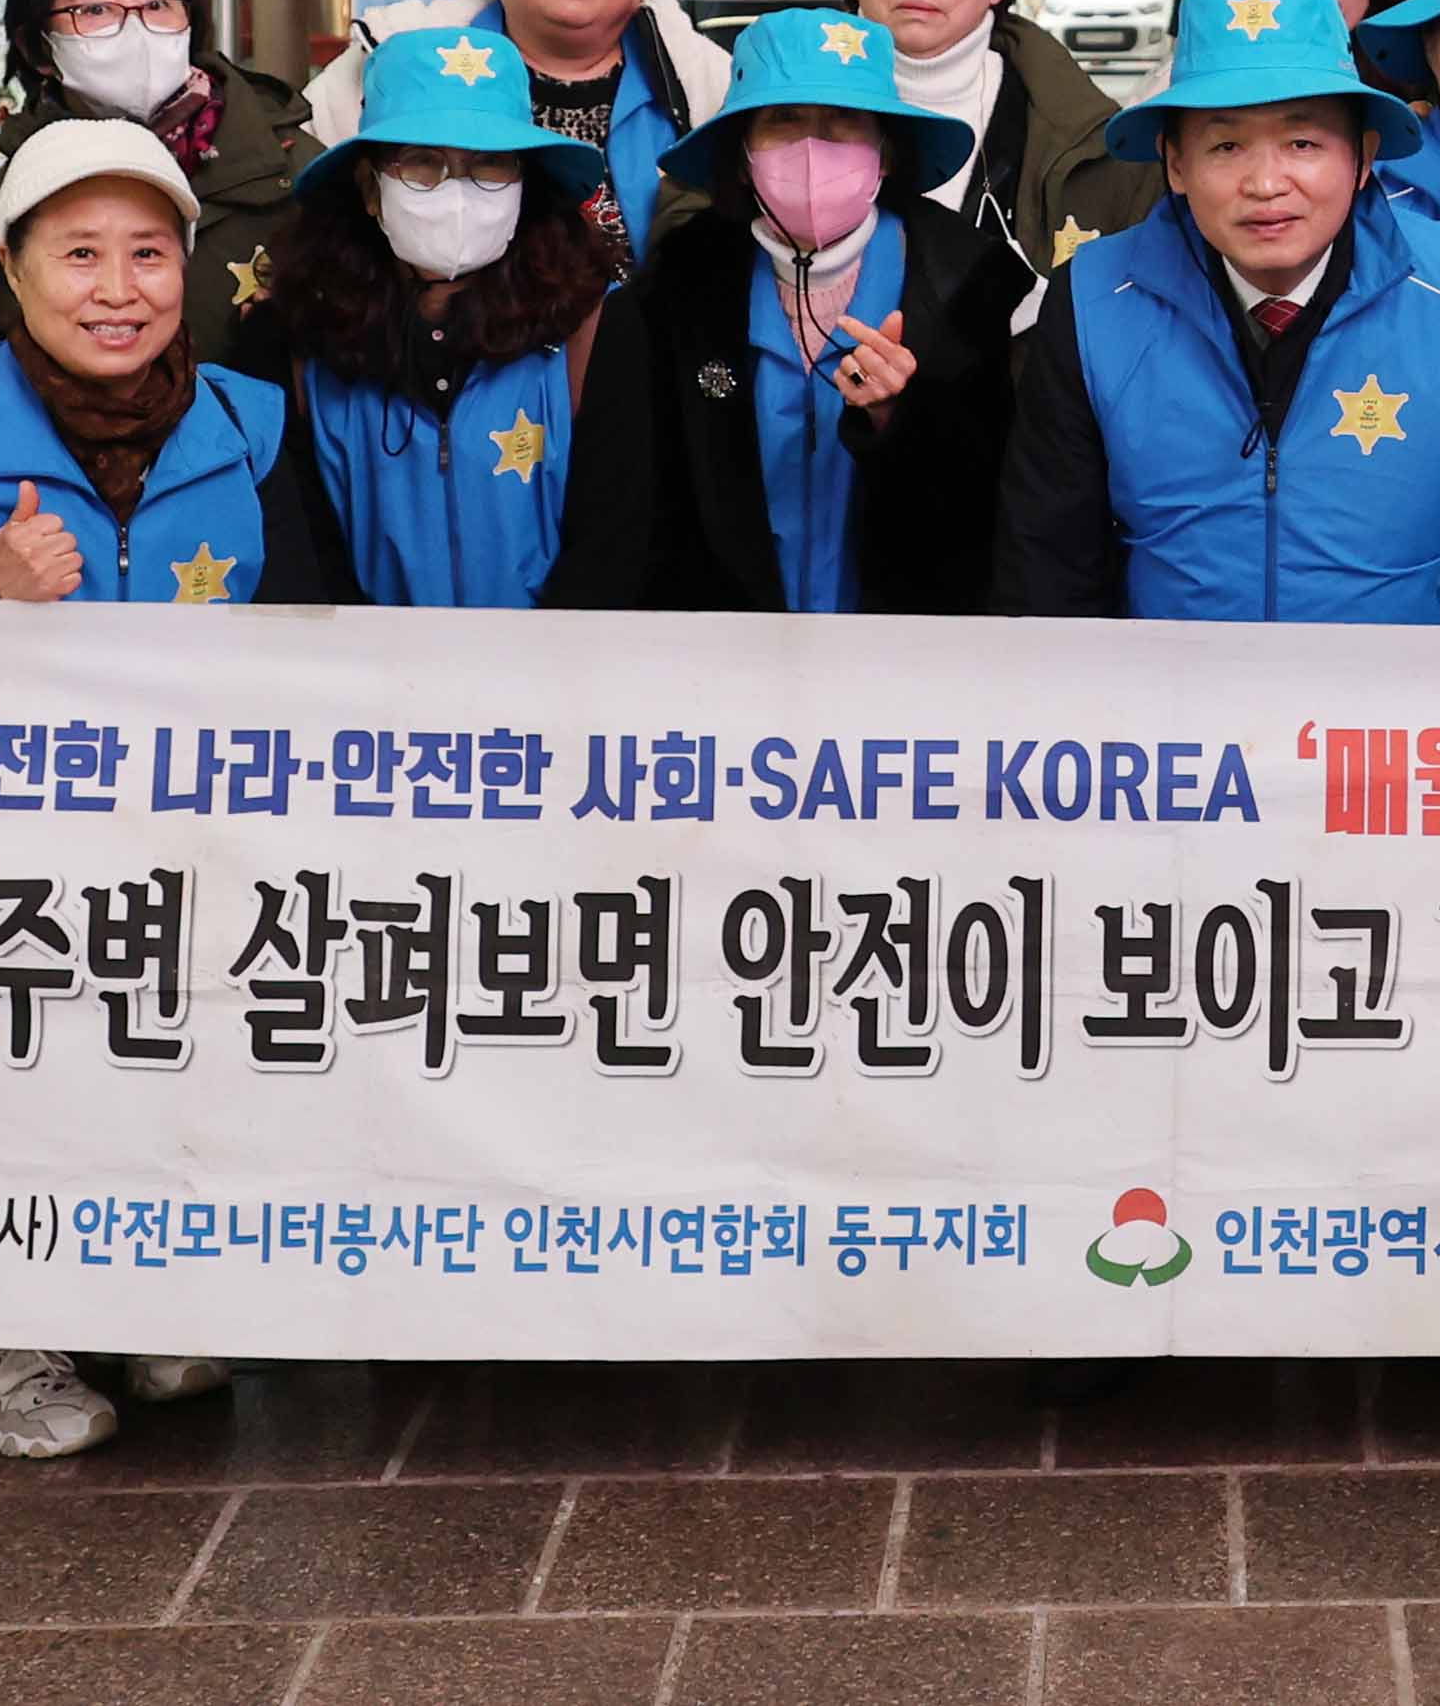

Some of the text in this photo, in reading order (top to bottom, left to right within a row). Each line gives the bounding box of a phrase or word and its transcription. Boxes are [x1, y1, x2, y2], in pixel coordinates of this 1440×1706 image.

[986, 741, 1261, 823] KOREA
[231, 871, 675, 1076] 살펴보면
[724, 877, 1044, 1077] 안전이
[1084, 880, 1403, 1083] 보이고
[74, 1198, 486, 1275] 안전모니터봉사단
[505, 1205, 807, 1275] 인천시연합회
[829, 1205, 1028, 1275] 동구지회
